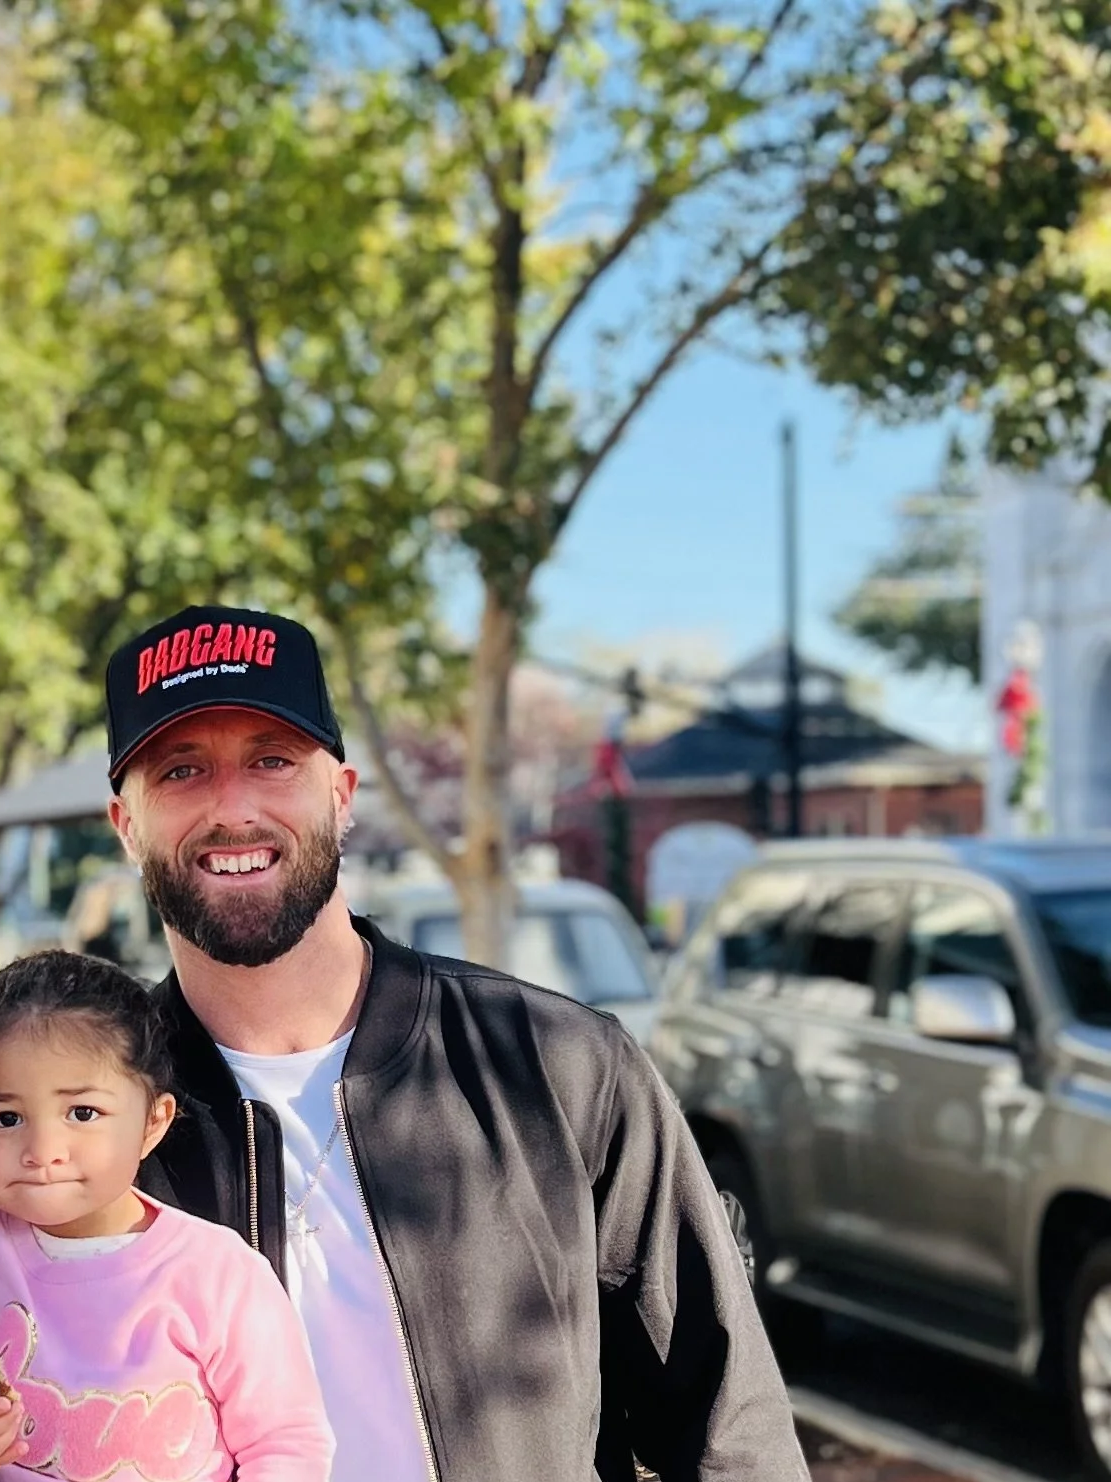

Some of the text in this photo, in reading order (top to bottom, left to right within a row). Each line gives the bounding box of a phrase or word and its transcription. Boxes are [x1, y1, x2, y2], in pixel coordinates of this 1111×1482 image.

[137, 623, 277, 695] DADGANG
[161, 667, 204, 690] Designed
[205, 664, 219, 676] by
